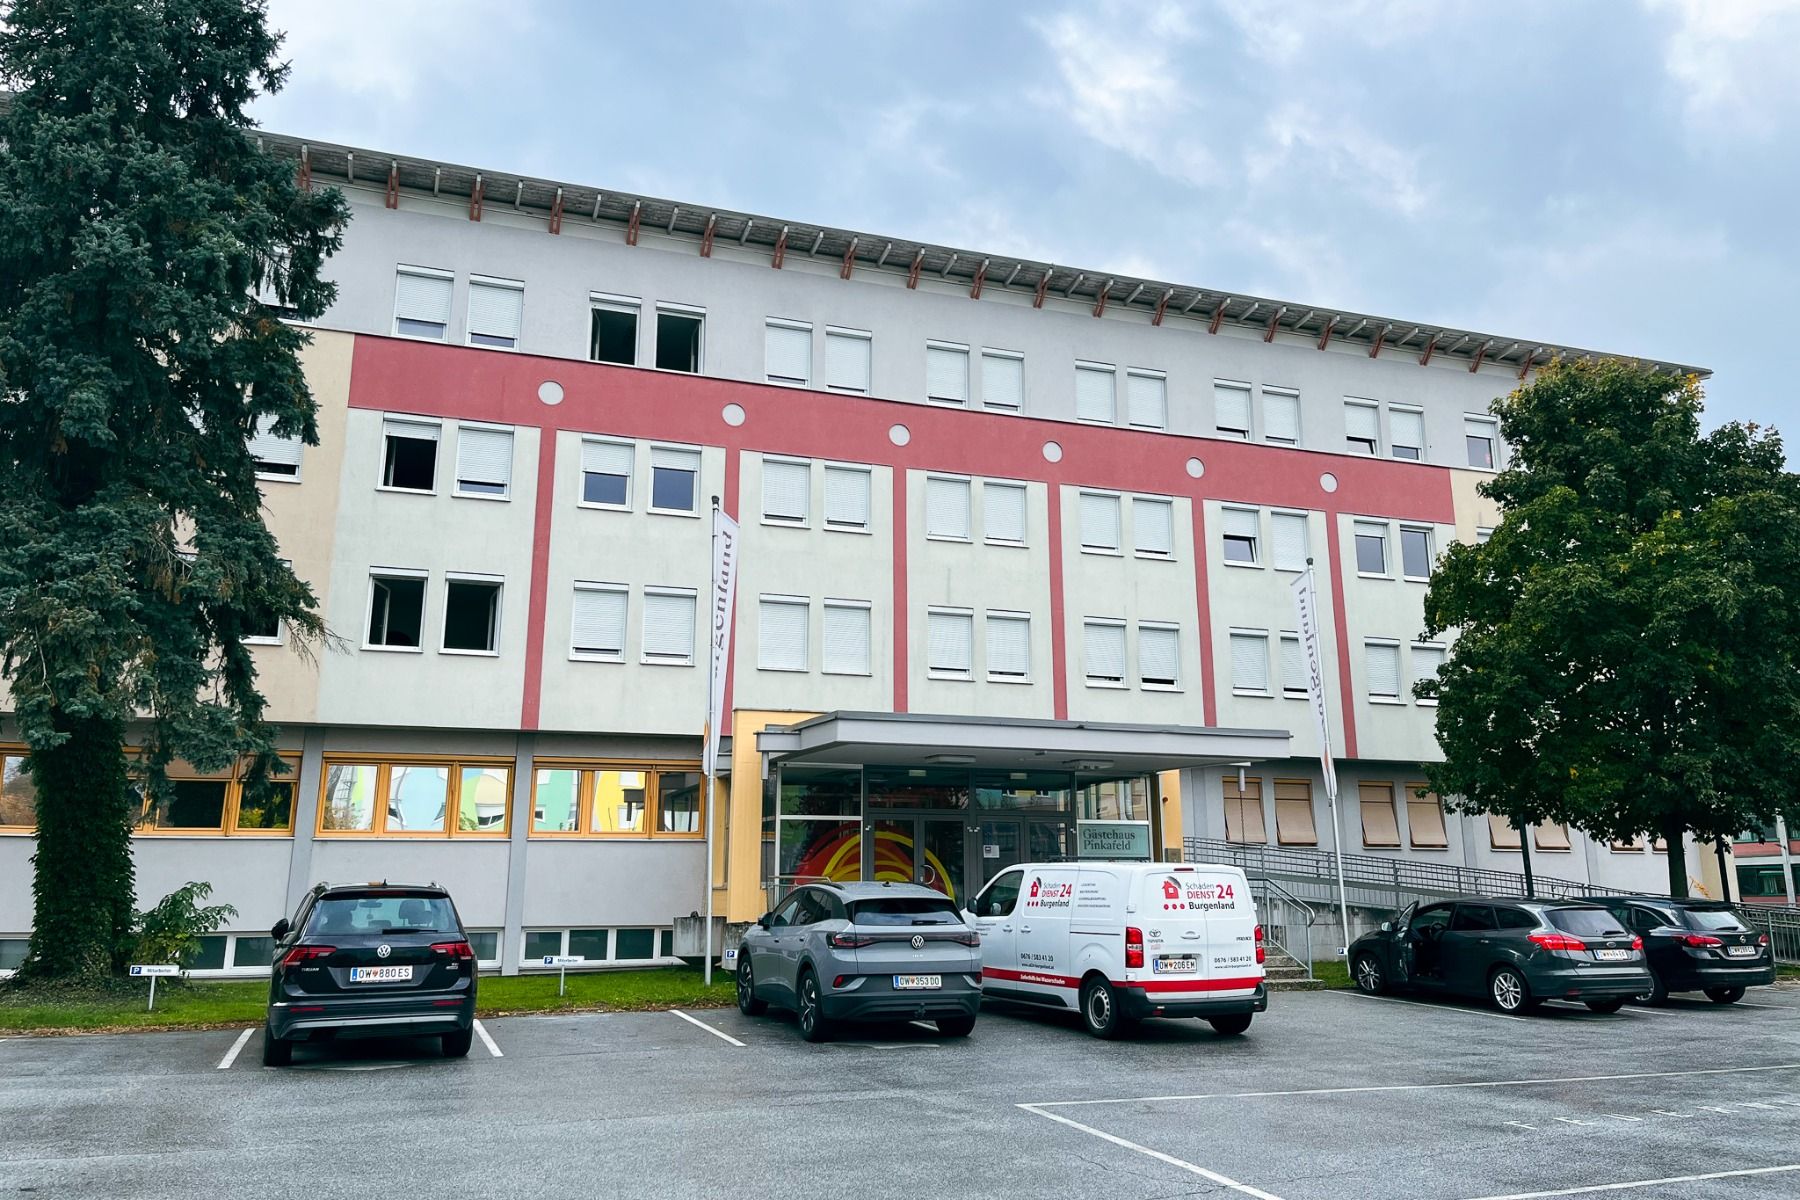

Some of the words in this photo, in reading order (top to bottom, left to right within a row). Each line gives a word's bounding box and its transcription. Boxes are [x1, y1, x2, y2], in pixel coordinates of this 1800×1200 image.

[1083, 828, 1136, 840] Gästehaus
[1084, 839, 1131, 850] Pinkafeld
[1042, 889, 1059, 897] DIENST
[1060, 884, 1072, 897] 24
[1187, 891, 1215, 899] DIENST
[1216, 884, 1234, 899] 24
[1040, 899, 1070, 909] Burgenland
[1188, 901, 1235, 911] Burgenland
